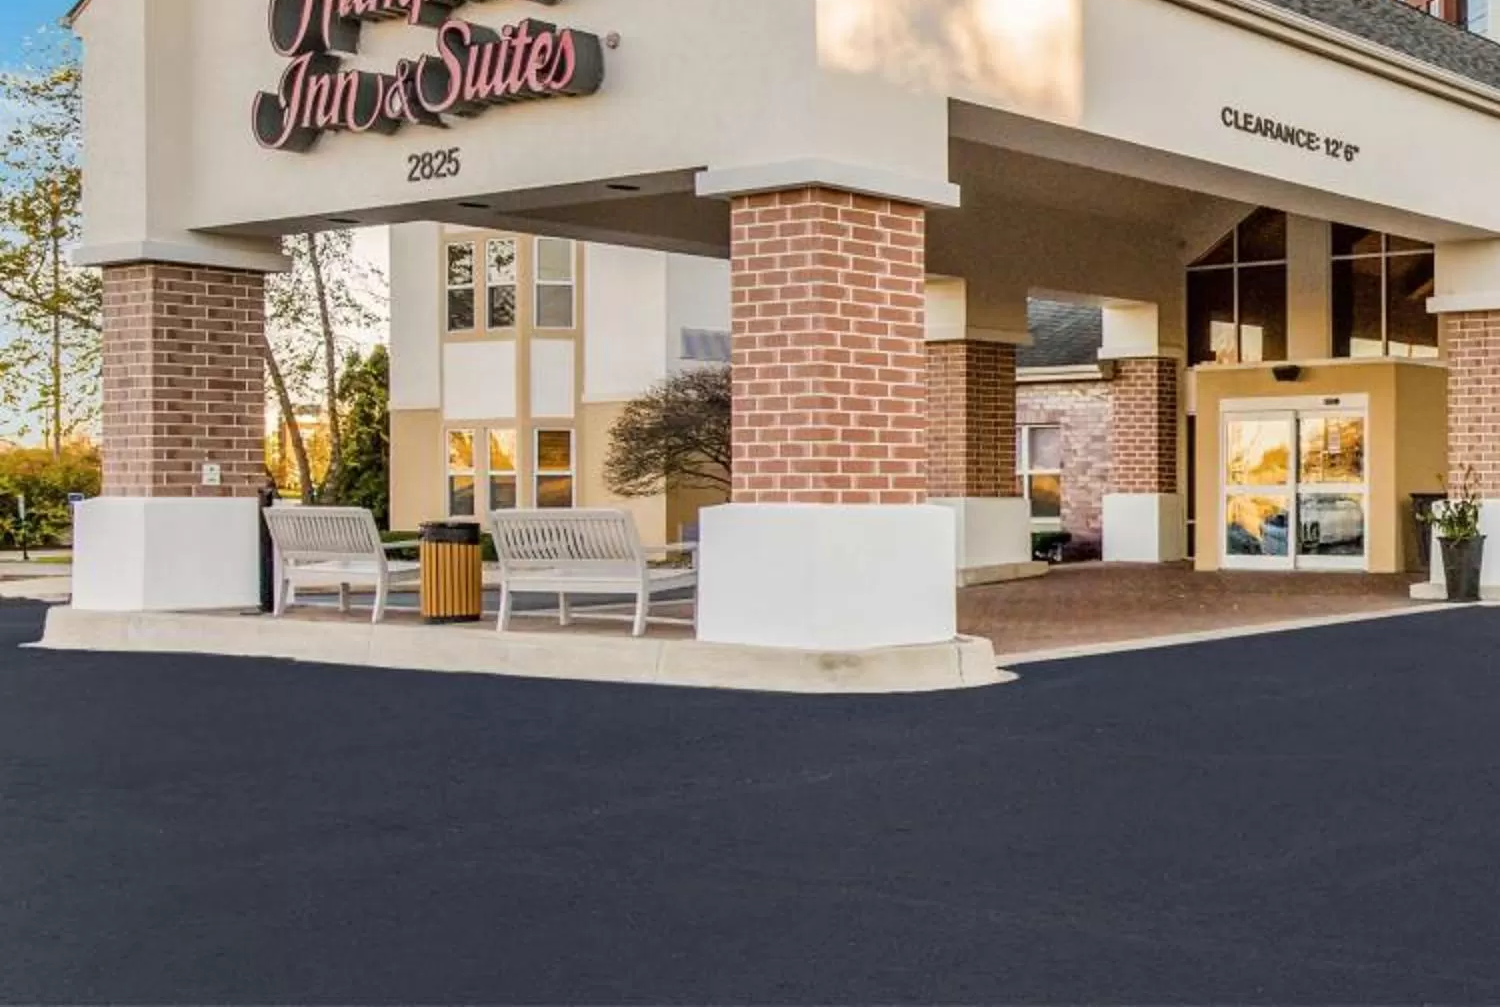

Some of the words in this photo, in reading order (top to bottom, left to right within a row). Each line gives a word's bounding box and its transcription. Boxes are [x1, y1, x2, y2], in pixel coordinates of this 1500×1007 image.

[251, 52, 388, 152] Inn
[384, 57, 432, 128] &
[416, 16, 600, 115] Suites
[1221, 106, 1321, 151] CLEARANCE:
[407, 147, 461, 182] 2825
